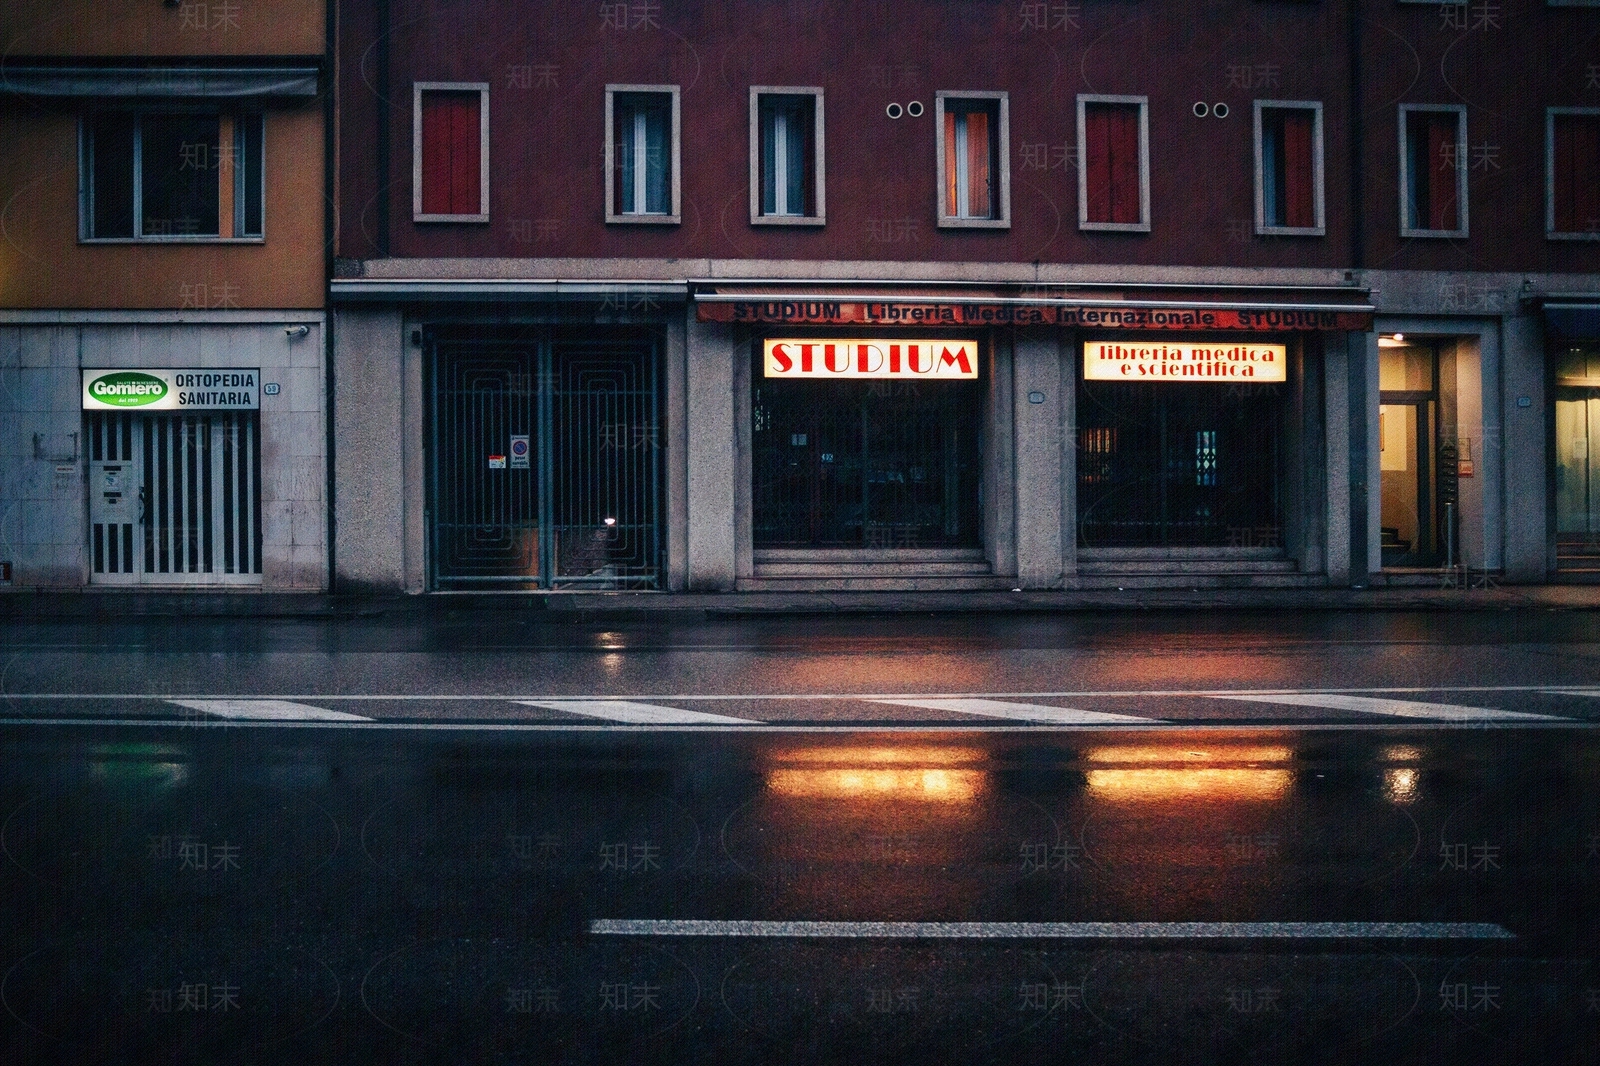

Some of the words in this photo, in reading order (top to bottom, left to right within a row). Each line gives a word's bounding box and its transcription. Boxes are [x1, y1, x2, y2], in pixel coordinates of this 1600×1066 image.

[733, 301, 841, 319] STUDIUM
[867, 302, 955, 321] Libreria
[963, 304, 1043, 321] Medica
[1055, 304, 1215, 326] Internazionale
[1238, 309, 1338, 328] STUDIUM
[771, 343, 973, 374] STUDIUM
[1100, 345, 1182, 362] libreria
[1191, 346, 1274, 363] medica
[1121, 364, 1131, 376] e
[1138, 361, 1255, 377] scientifica
[93, 381, 163, 396] Gomiero
[175, 373, 254, 388] ORTOPEDIA
[178, 391, 251, 405] SANITARIA
